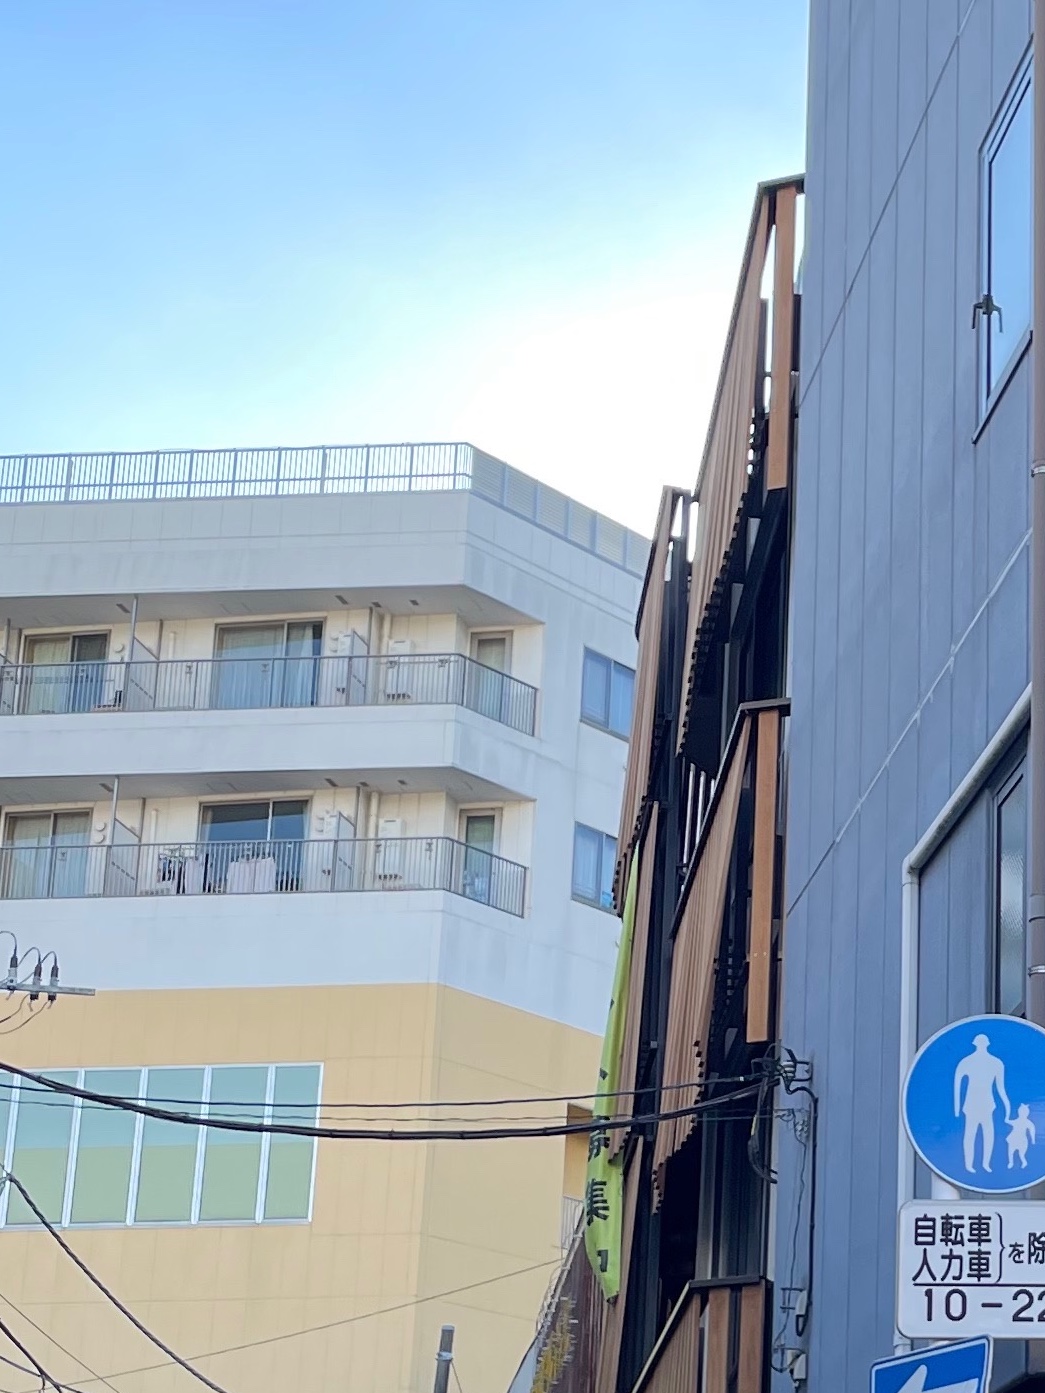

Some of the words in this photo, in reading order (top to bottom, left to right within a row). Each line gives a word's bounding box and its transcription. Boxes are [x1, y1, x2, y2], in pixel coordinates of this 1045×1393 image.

[913, 1213, 992, 1248] 自転車
[912, 1249, 992, 1282] 人力車
